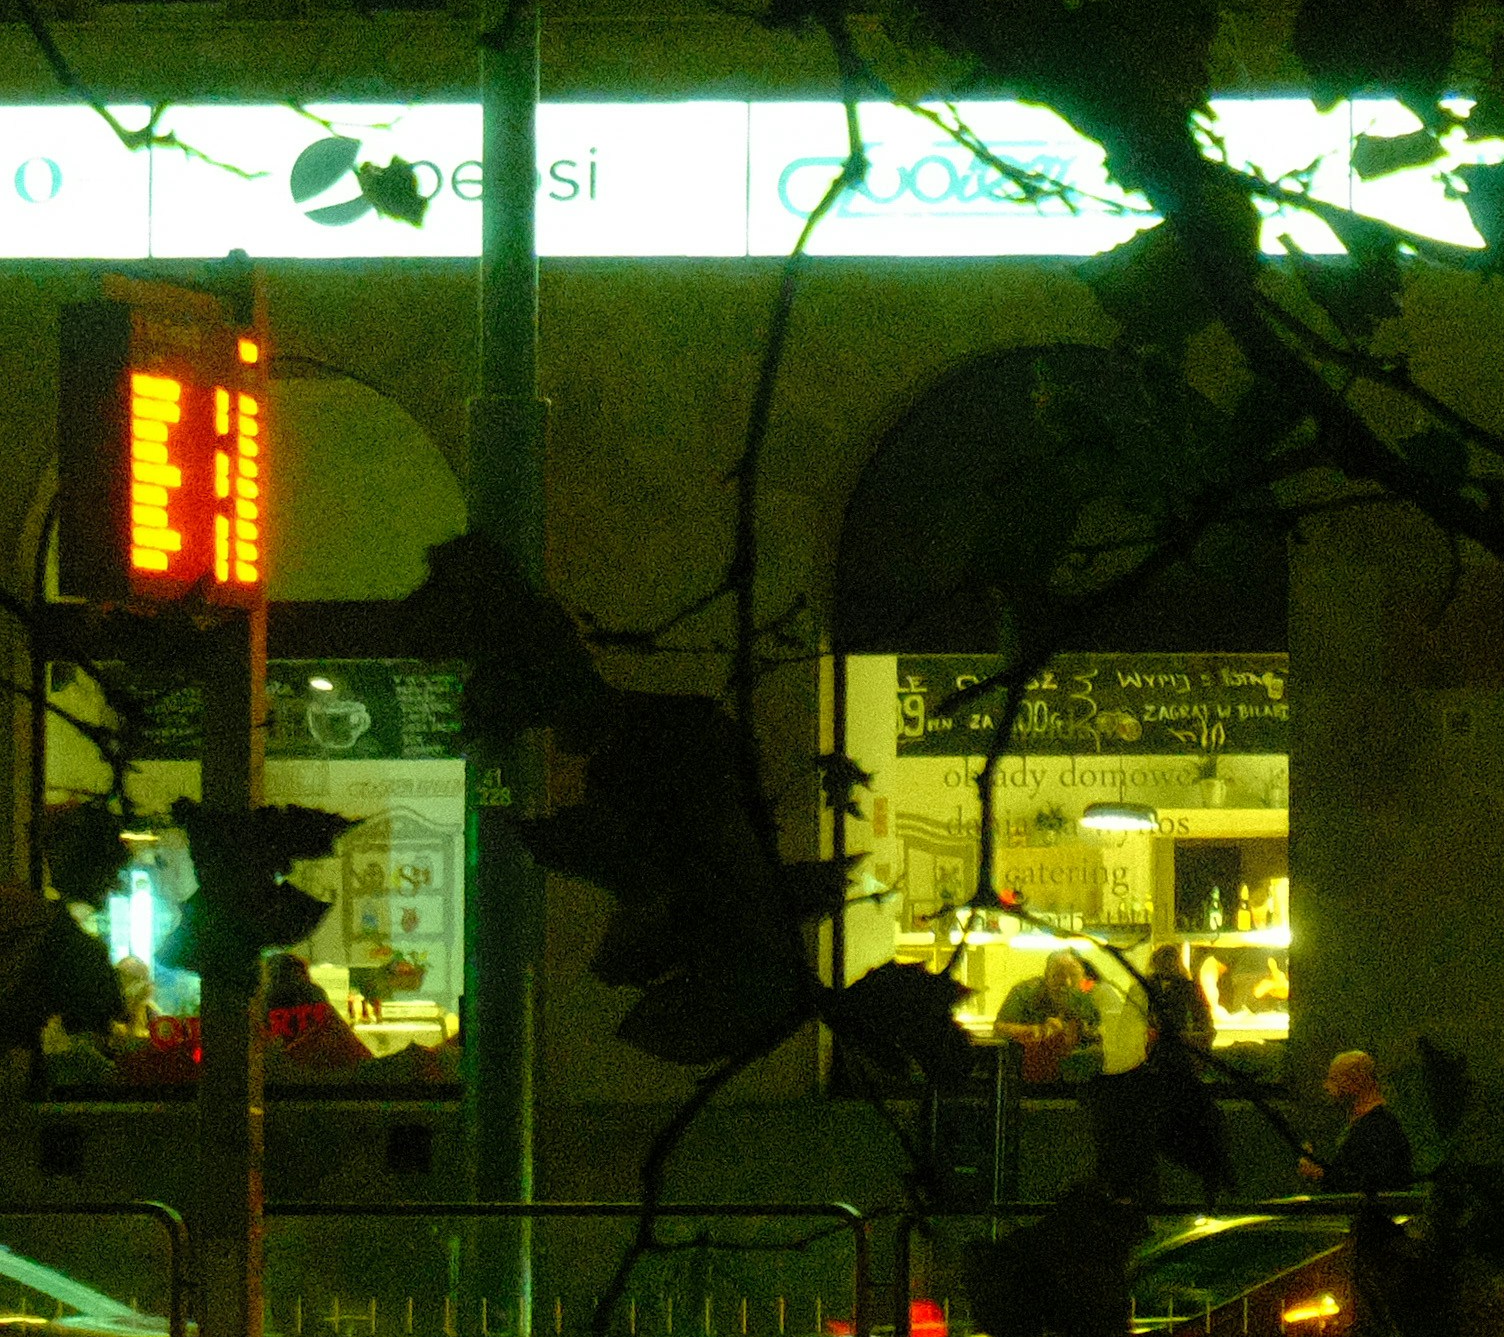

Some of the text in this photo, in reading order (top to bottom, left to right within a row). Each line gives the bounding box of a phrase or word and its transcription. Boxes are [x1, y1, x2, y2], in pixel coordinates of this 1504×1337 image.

[404, 148, 597, 209] esi
[943, 756, 1198, 800] obady domowe
[1004, 861, 1130, 895] catering
